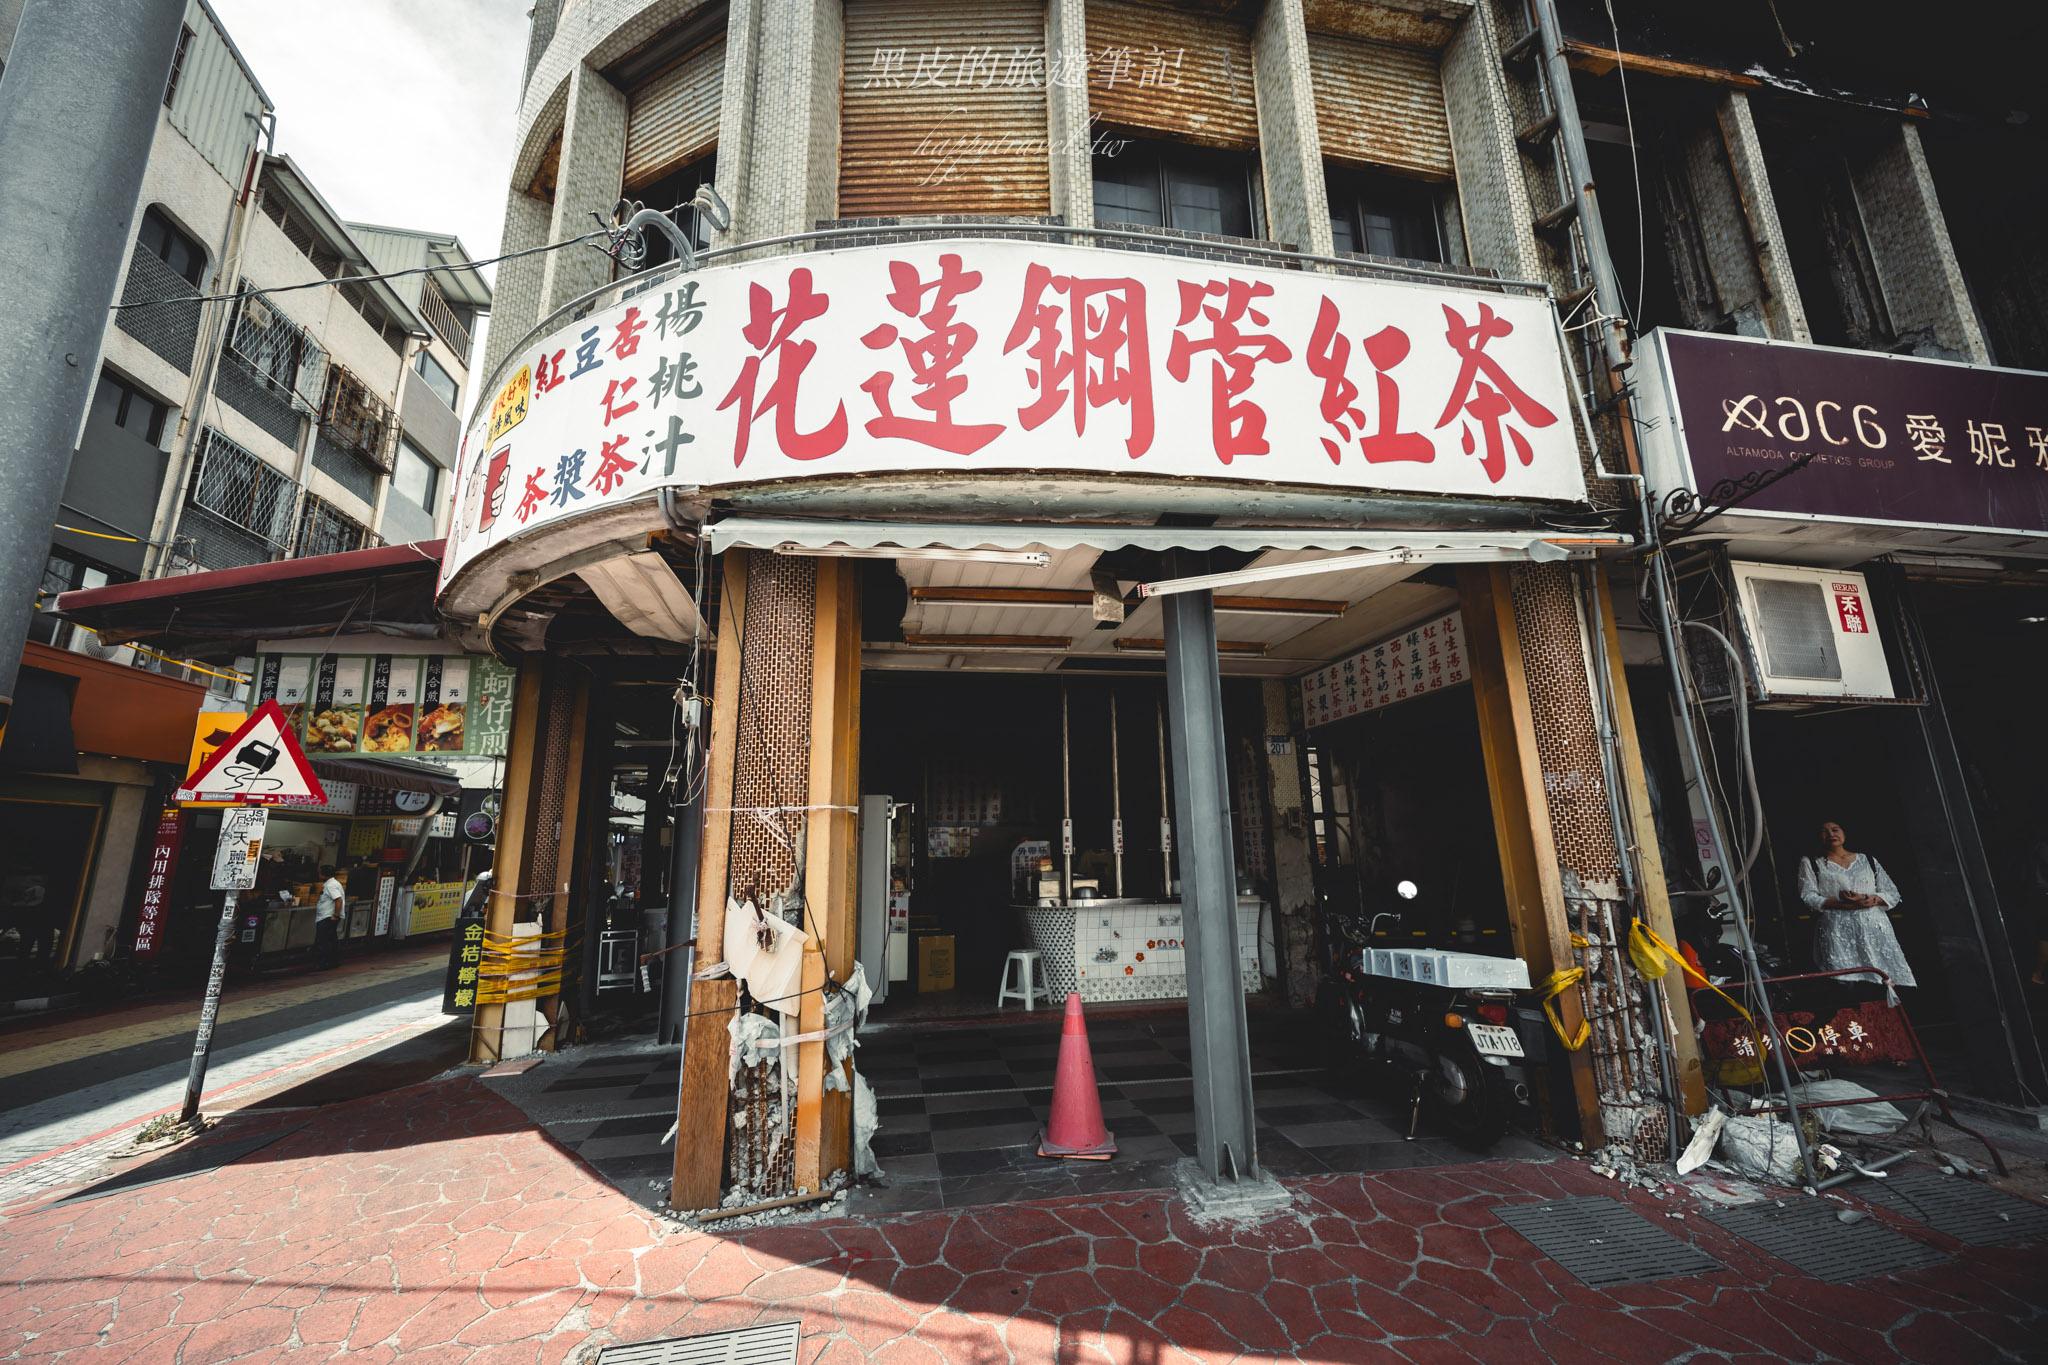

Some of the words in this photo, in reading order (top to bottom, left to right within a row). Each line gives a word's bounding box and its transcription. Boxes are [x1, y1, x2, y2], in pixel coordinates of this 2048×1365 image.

[640, 280, 707, 477] 楊桃汁
[716, 253, 1559, 485] 花蓮鋼管紅茶
[551, 325, 603, 508] 豆漿
[587, 306, 648, 496] 杏仁茶
[513, 348, 566, 524] 紅茶
[1726, 446, 1784, 460] ALTAMODA
[1858, 457, 1896, 471] GROUP
[1833, 583, 1858, 592] HERAN
[1841, 596, 1862, 632] 禾聯
[1390, 638, 1405, 686] 西瓜汁
[1423, 625, 1442, 675] 紅豆湯
[1442, 618, 1461, 669] 花生湯
[286, 688, 297, 698] 元
[319, 661, 336, 702] 蚵仔煎
[342, 688, 353, 698] 元
[373, 661, 390, 703] 花枝煎
[397, 688, 407, 698] 元
[425, 662, 442, 703] 綜合煎
[449, 688, 459, 698] 元
[1396, 687, 1407, 698] 45
[1413, 682, 1425, 694] 45
[1430, 676, 1442, 688] 45
[1450, 670, 1463, 683] 55
[479, 671, 516, 756] 蚵仔煎
[1380, 693, 1390, 704] 45
[1270, 743, 1286, 755] 201
[135, 845, 171, 952] 內用排隊等候區
[454, 923, 483, 1008] 金桔檸檬
